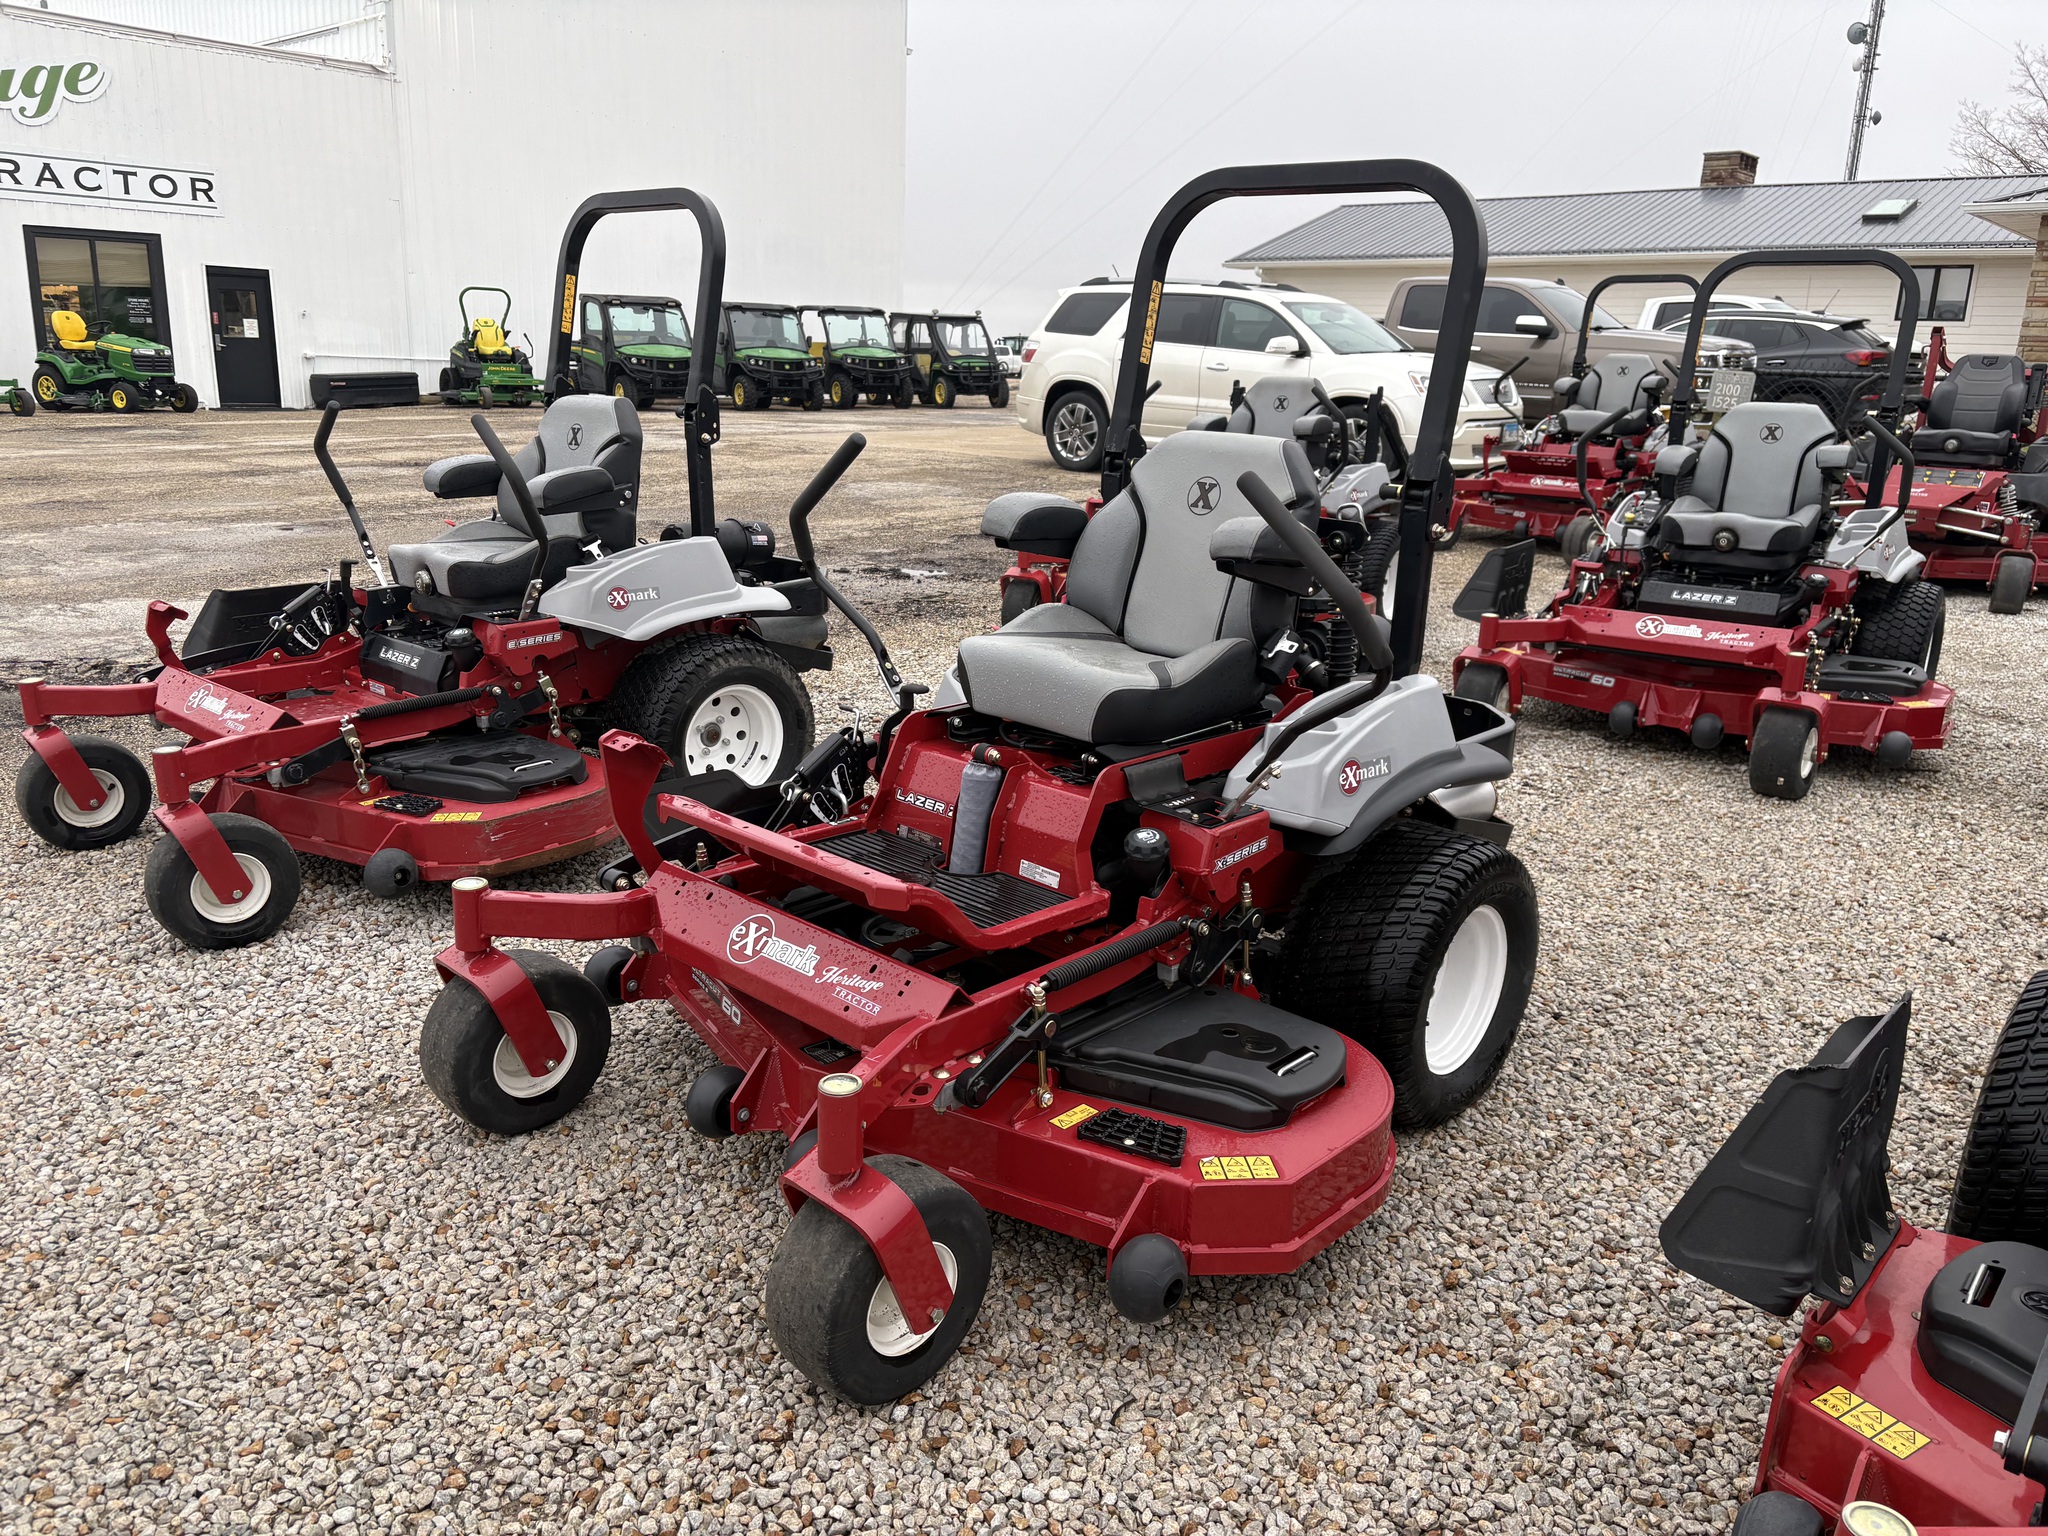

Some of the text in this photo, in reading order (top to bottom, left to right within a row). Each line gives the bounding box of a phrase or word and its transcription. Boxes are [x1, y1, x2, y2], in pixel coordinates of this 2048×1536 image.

[1715, 383, 1741, 396] 2100
[1712, 396, 1738, 410] 1525
[607, 588, 658, 608] eXmark
[1671, 590, 1738, 605] LAZER Z
[1636, 618, 1703, 638] eXmark
[1704, 631, 1750, 641] Heritage
[379, 647, 421, 669] LAZER Z
[1553, 666, 1591, 678] ULTRACUT
[1591, 674, 1616, 688] 60
[186, 686, 229, 715] eXmark
[1340, 759, 1389, 790] eXmark
[896, 788, 946, 815] LAZER
[730, 918, 821, 976] eXmark
[814, 966, 885, 993] Heritage
[722, 994, 741, 1026] 60
[833, 987, 882, 1015] TRACTOR
